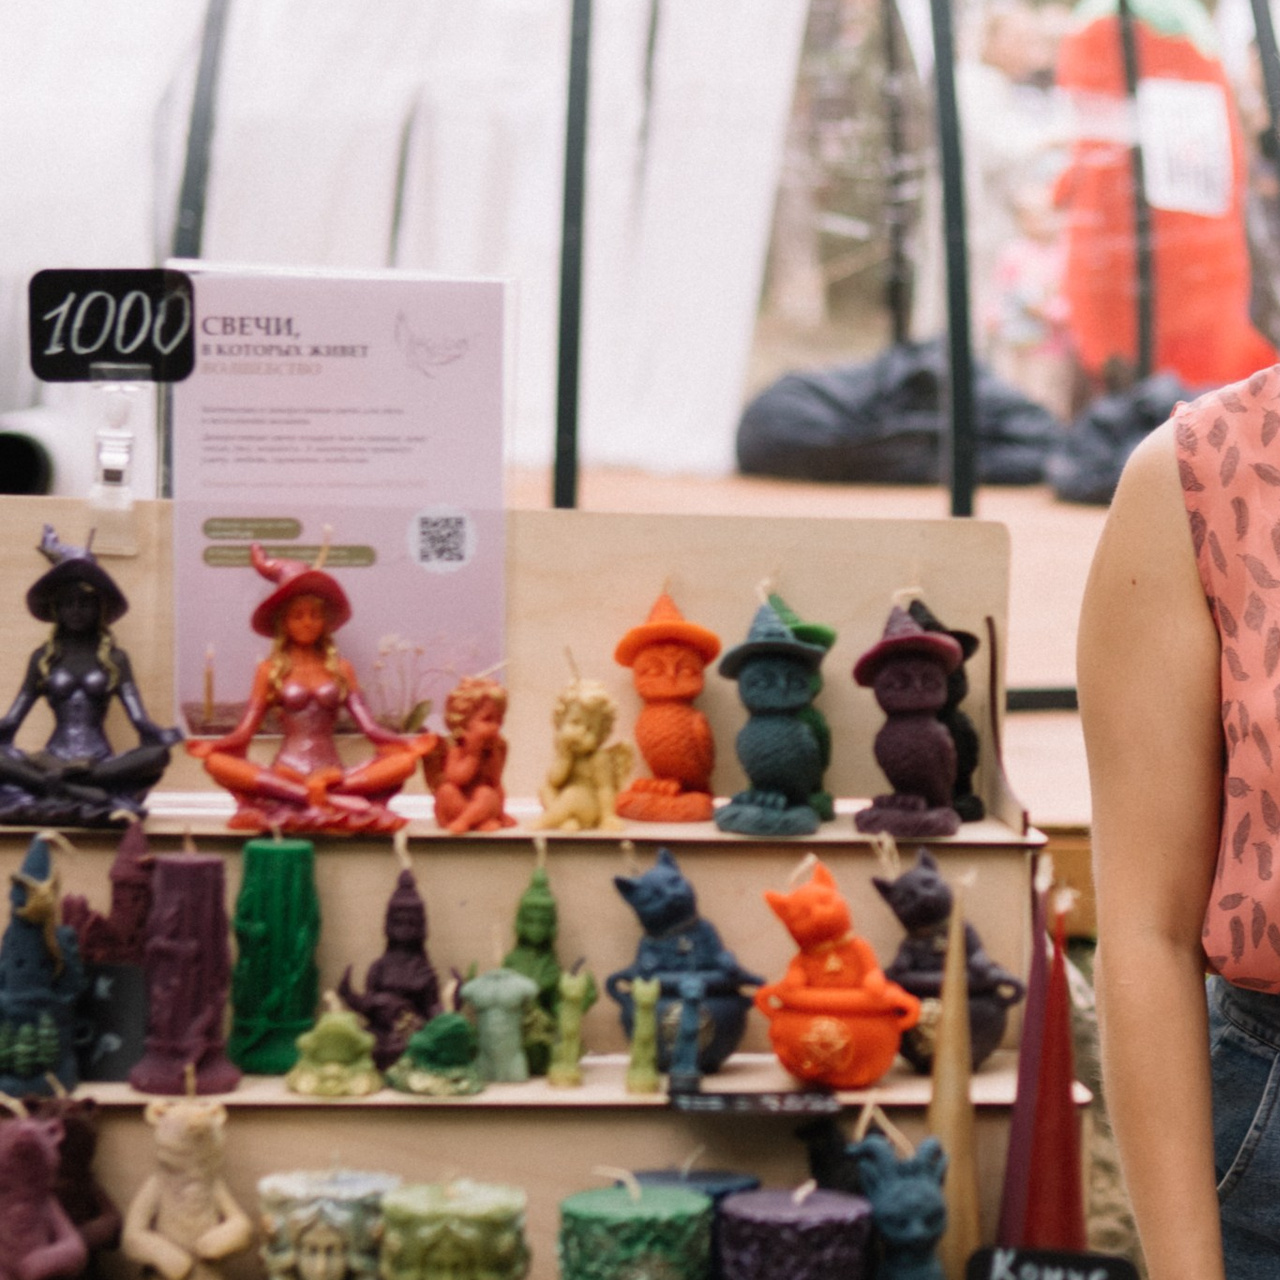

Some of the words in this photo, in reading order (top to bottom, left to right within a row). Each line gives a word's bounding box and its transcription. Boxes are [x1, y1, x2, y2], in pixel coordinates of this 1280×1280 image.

[42, 289, 191, 356] 1000
[201, 316, 301, 339] СВЕЧИ,
[216, 344, 303, 357] КОТОРЫХ
